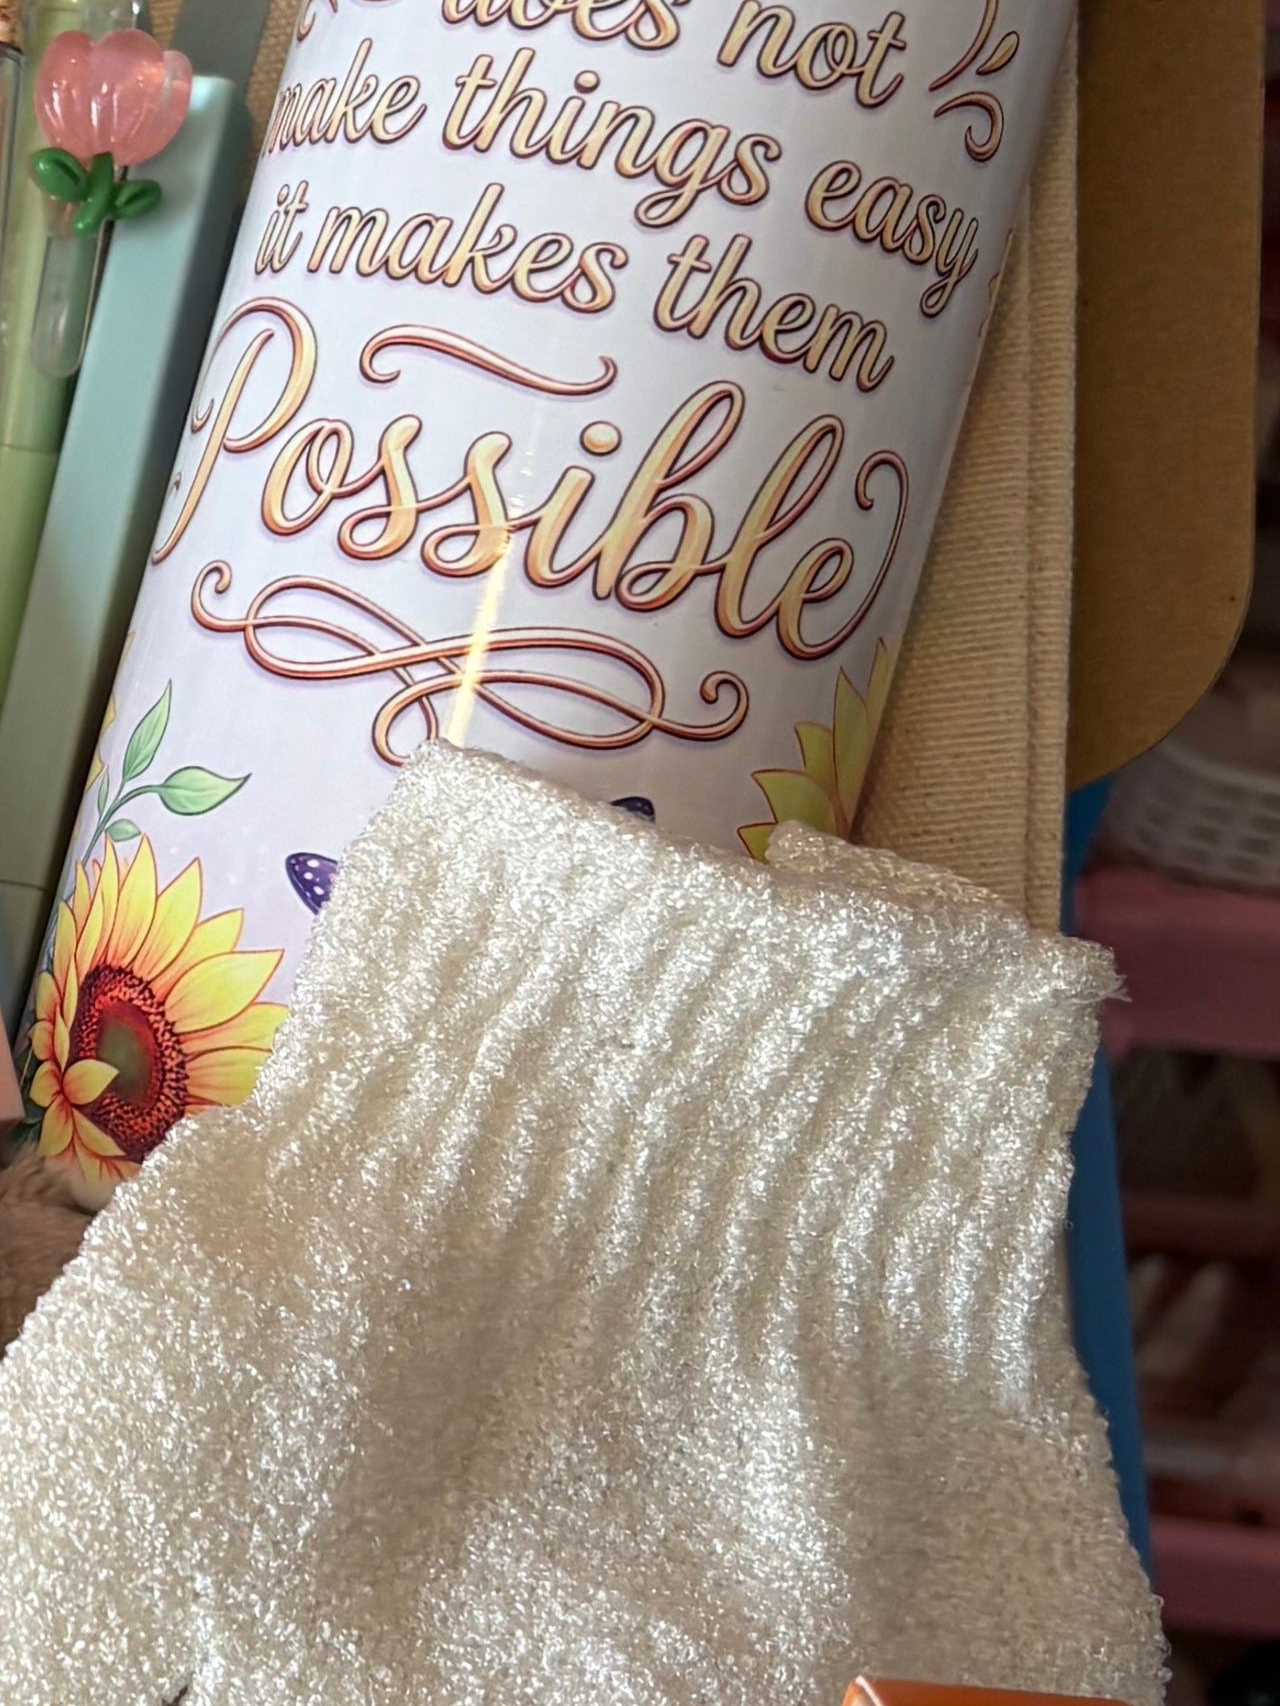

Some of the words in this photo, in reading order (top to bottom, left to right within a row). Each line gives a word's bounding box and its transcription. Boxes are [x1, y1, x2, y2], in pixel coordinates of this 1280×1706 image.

[253, 184, 307, 279] it
[307, 182, 629, 319] makes
[649, 235, 897, 397] them
[262, 38, 428, 167] make
[442, 47, 783, 229] things
[805, 157, 983, 320] easy
[151, 295, 912, 666] Possible
